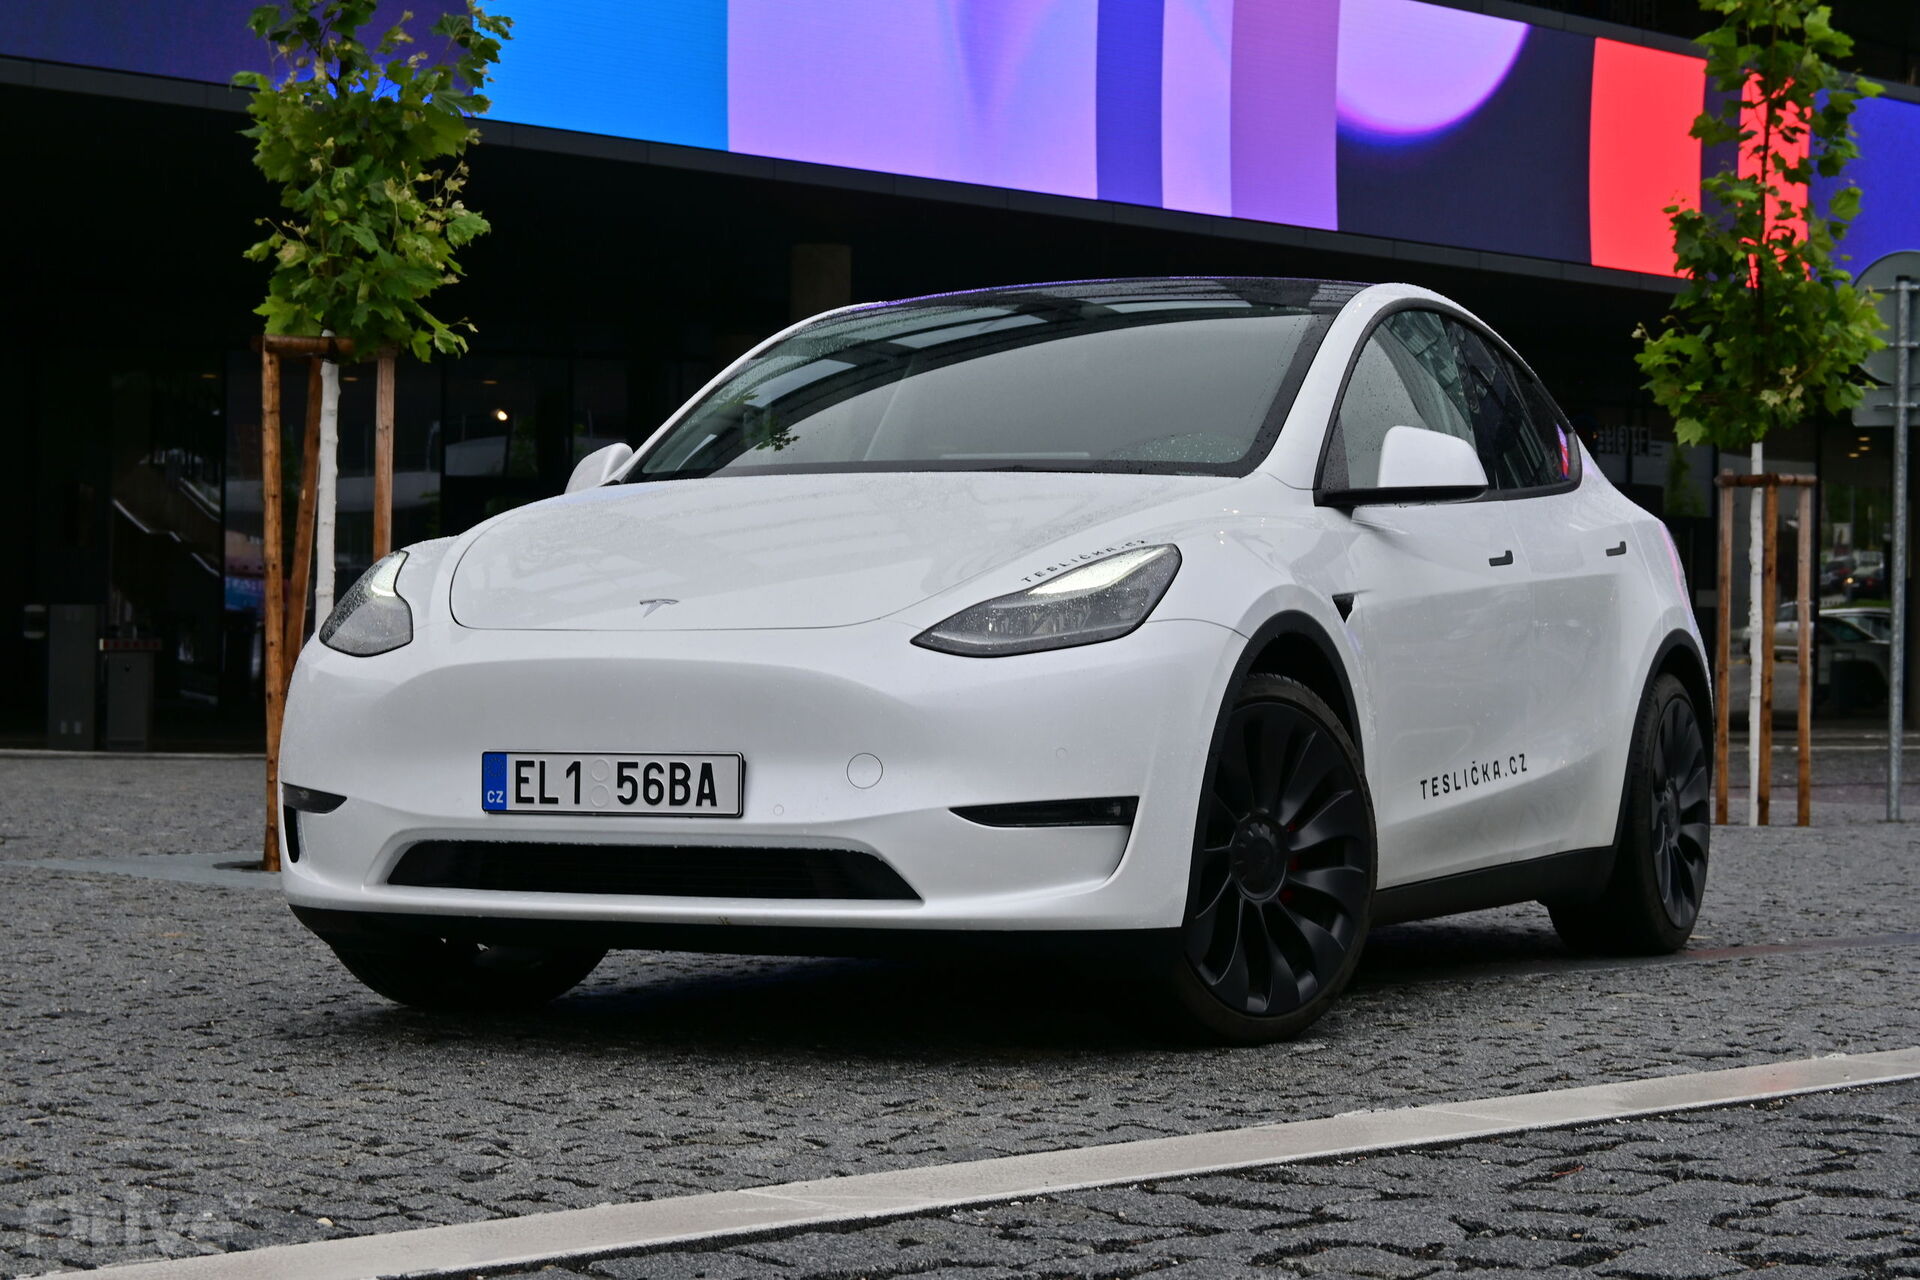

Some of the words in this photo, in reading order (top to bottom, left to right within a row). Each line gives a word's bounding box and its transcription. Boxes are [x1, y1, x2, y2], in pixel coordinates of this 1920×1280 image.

[487, 790, 504, 804] CZ
[515, 760, 582, 805] EL1
[617, 761, 718, 808] 56BA
[1420, 753, 1528, 800] TESLIČKA.CZ
